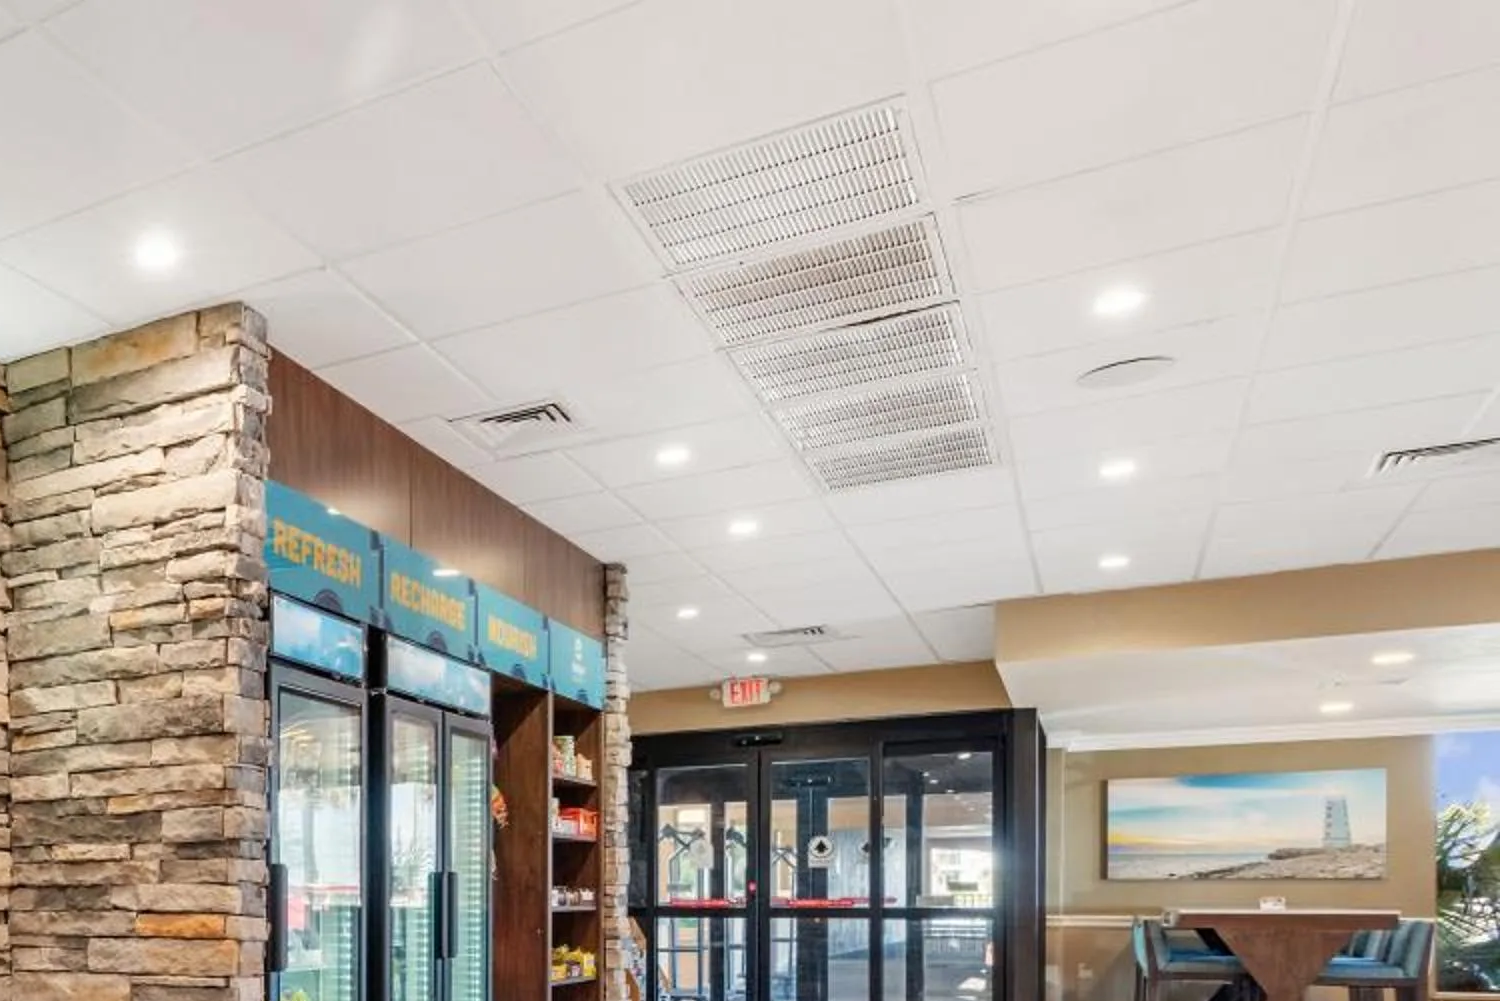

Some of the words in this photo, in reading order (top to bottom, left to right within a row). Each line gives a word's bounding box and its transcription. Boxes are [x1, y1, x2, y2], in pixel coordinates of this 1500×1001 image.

[273, 517, 362, 590] REFRESH
[390, 571, 467, 632] RECHARGE
[730, 679, 765, 705] EXIT
